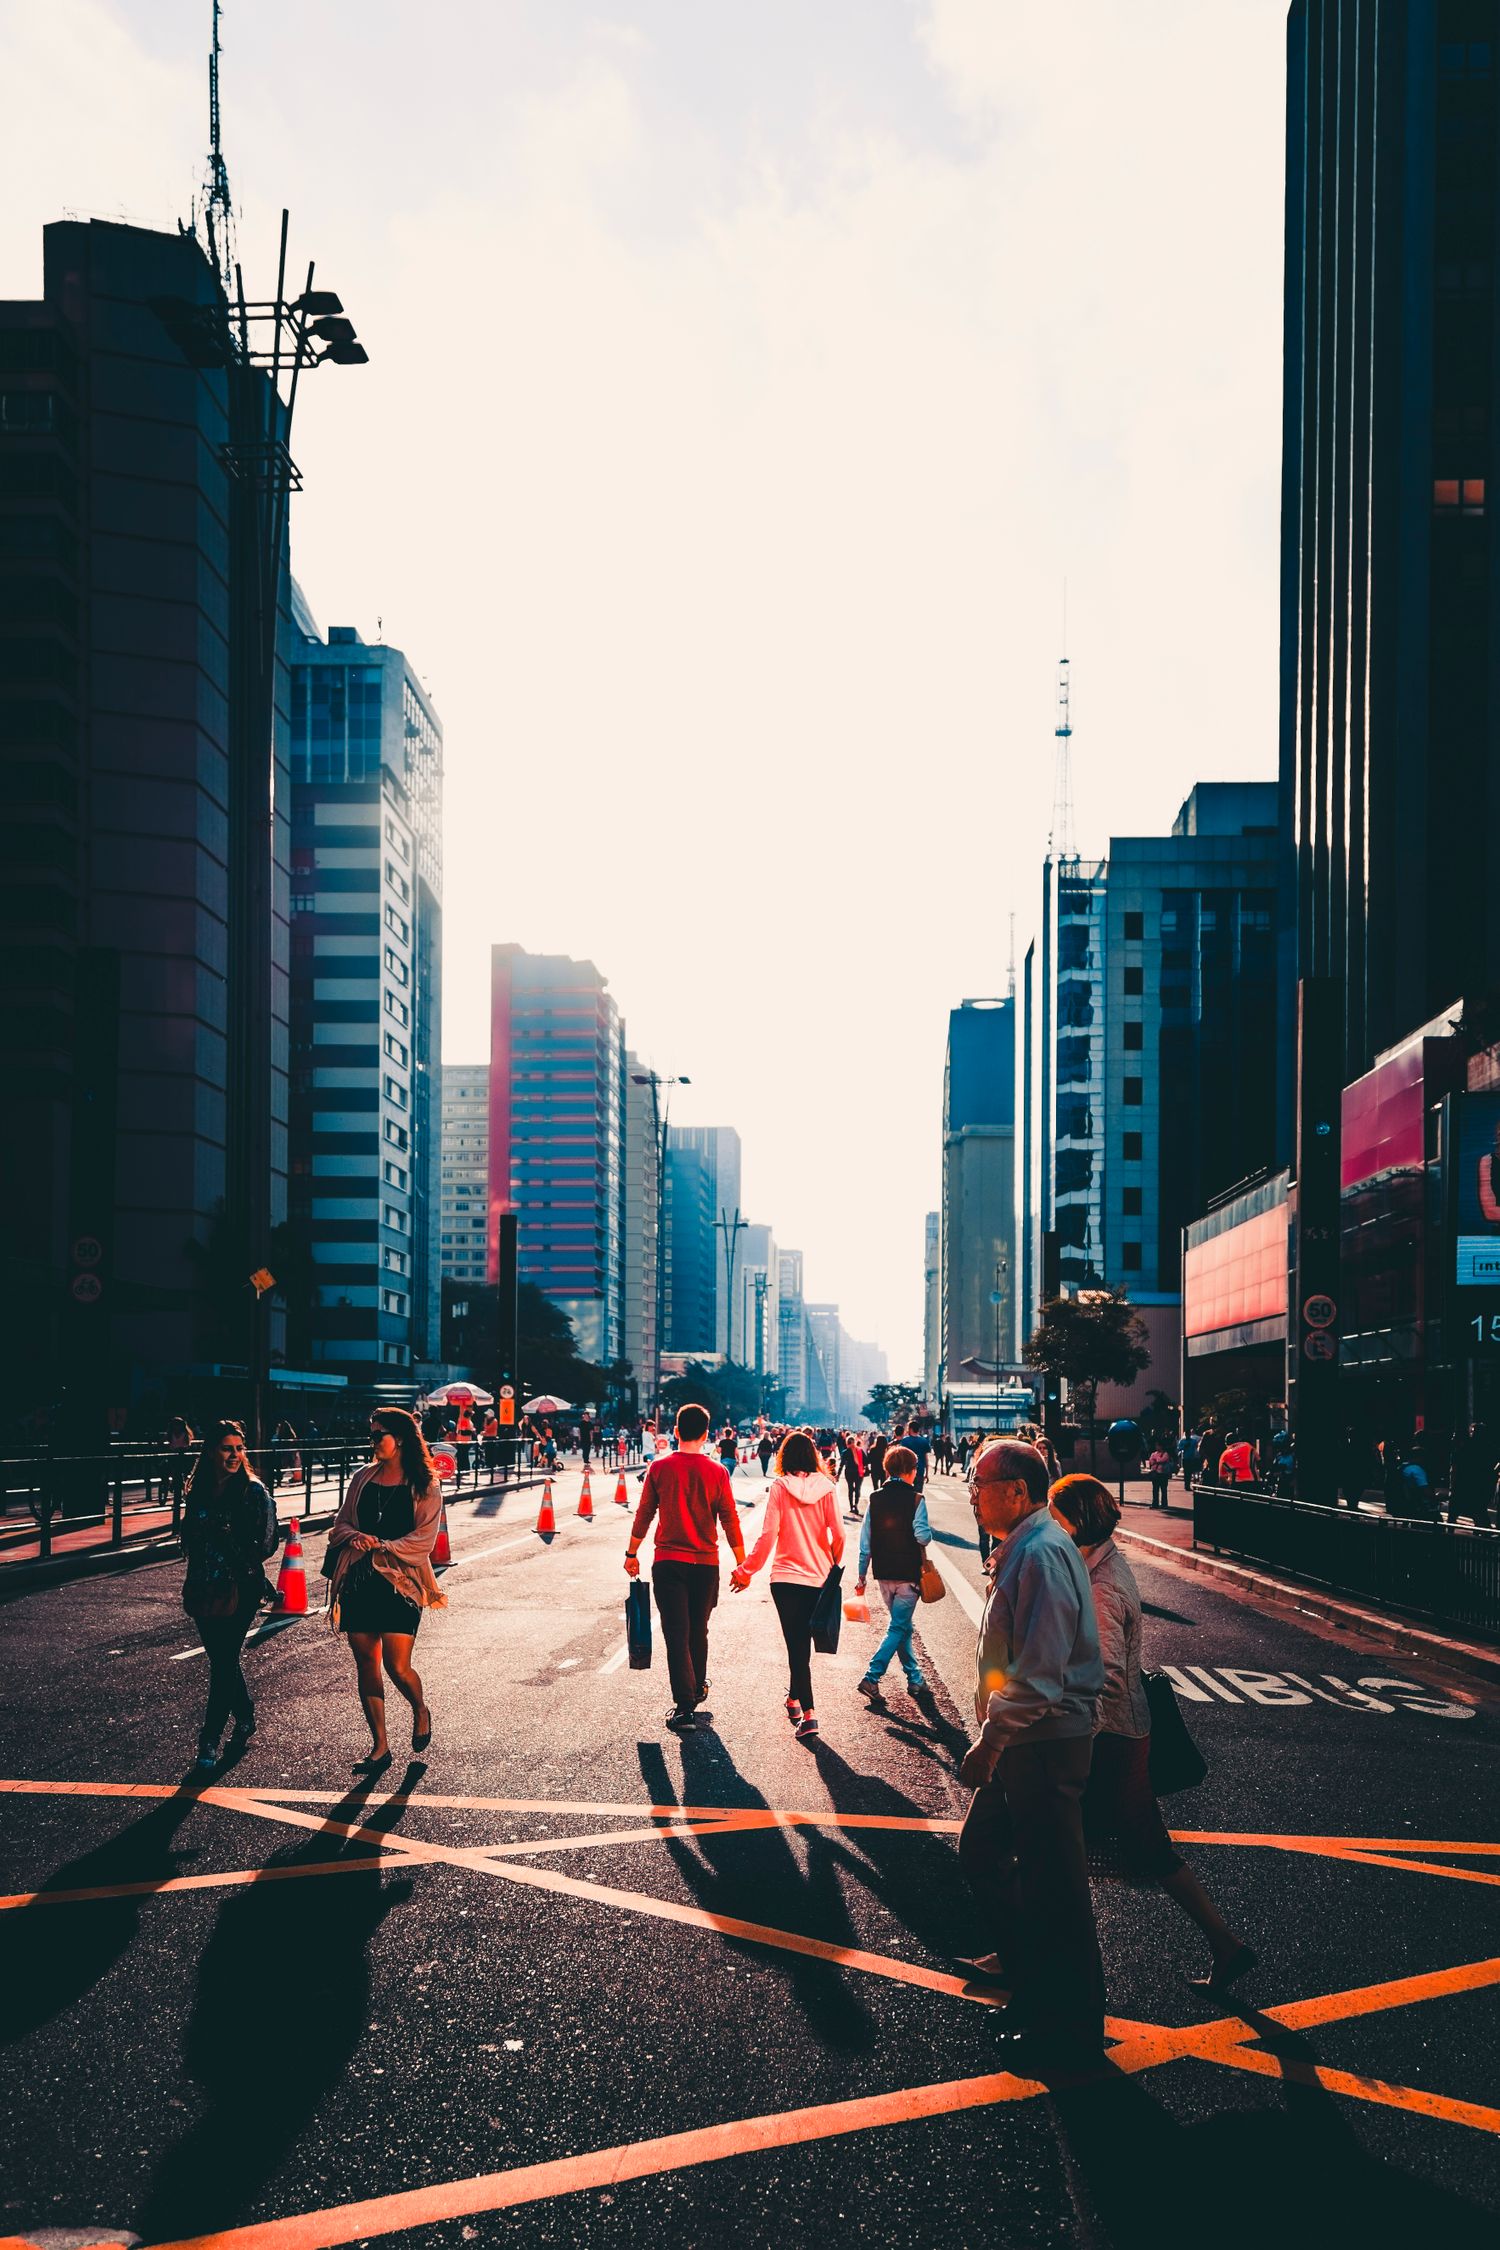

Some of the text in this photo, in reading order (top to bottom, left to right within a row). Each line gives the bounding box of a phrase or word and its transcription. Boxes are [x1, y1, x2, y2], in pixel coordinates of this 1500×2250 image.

[78, 1243, 98, 1257] 50
[1309, 1303, 1331, 1317] 50
[1141, 1665, 1476, 1719] NIBUS
